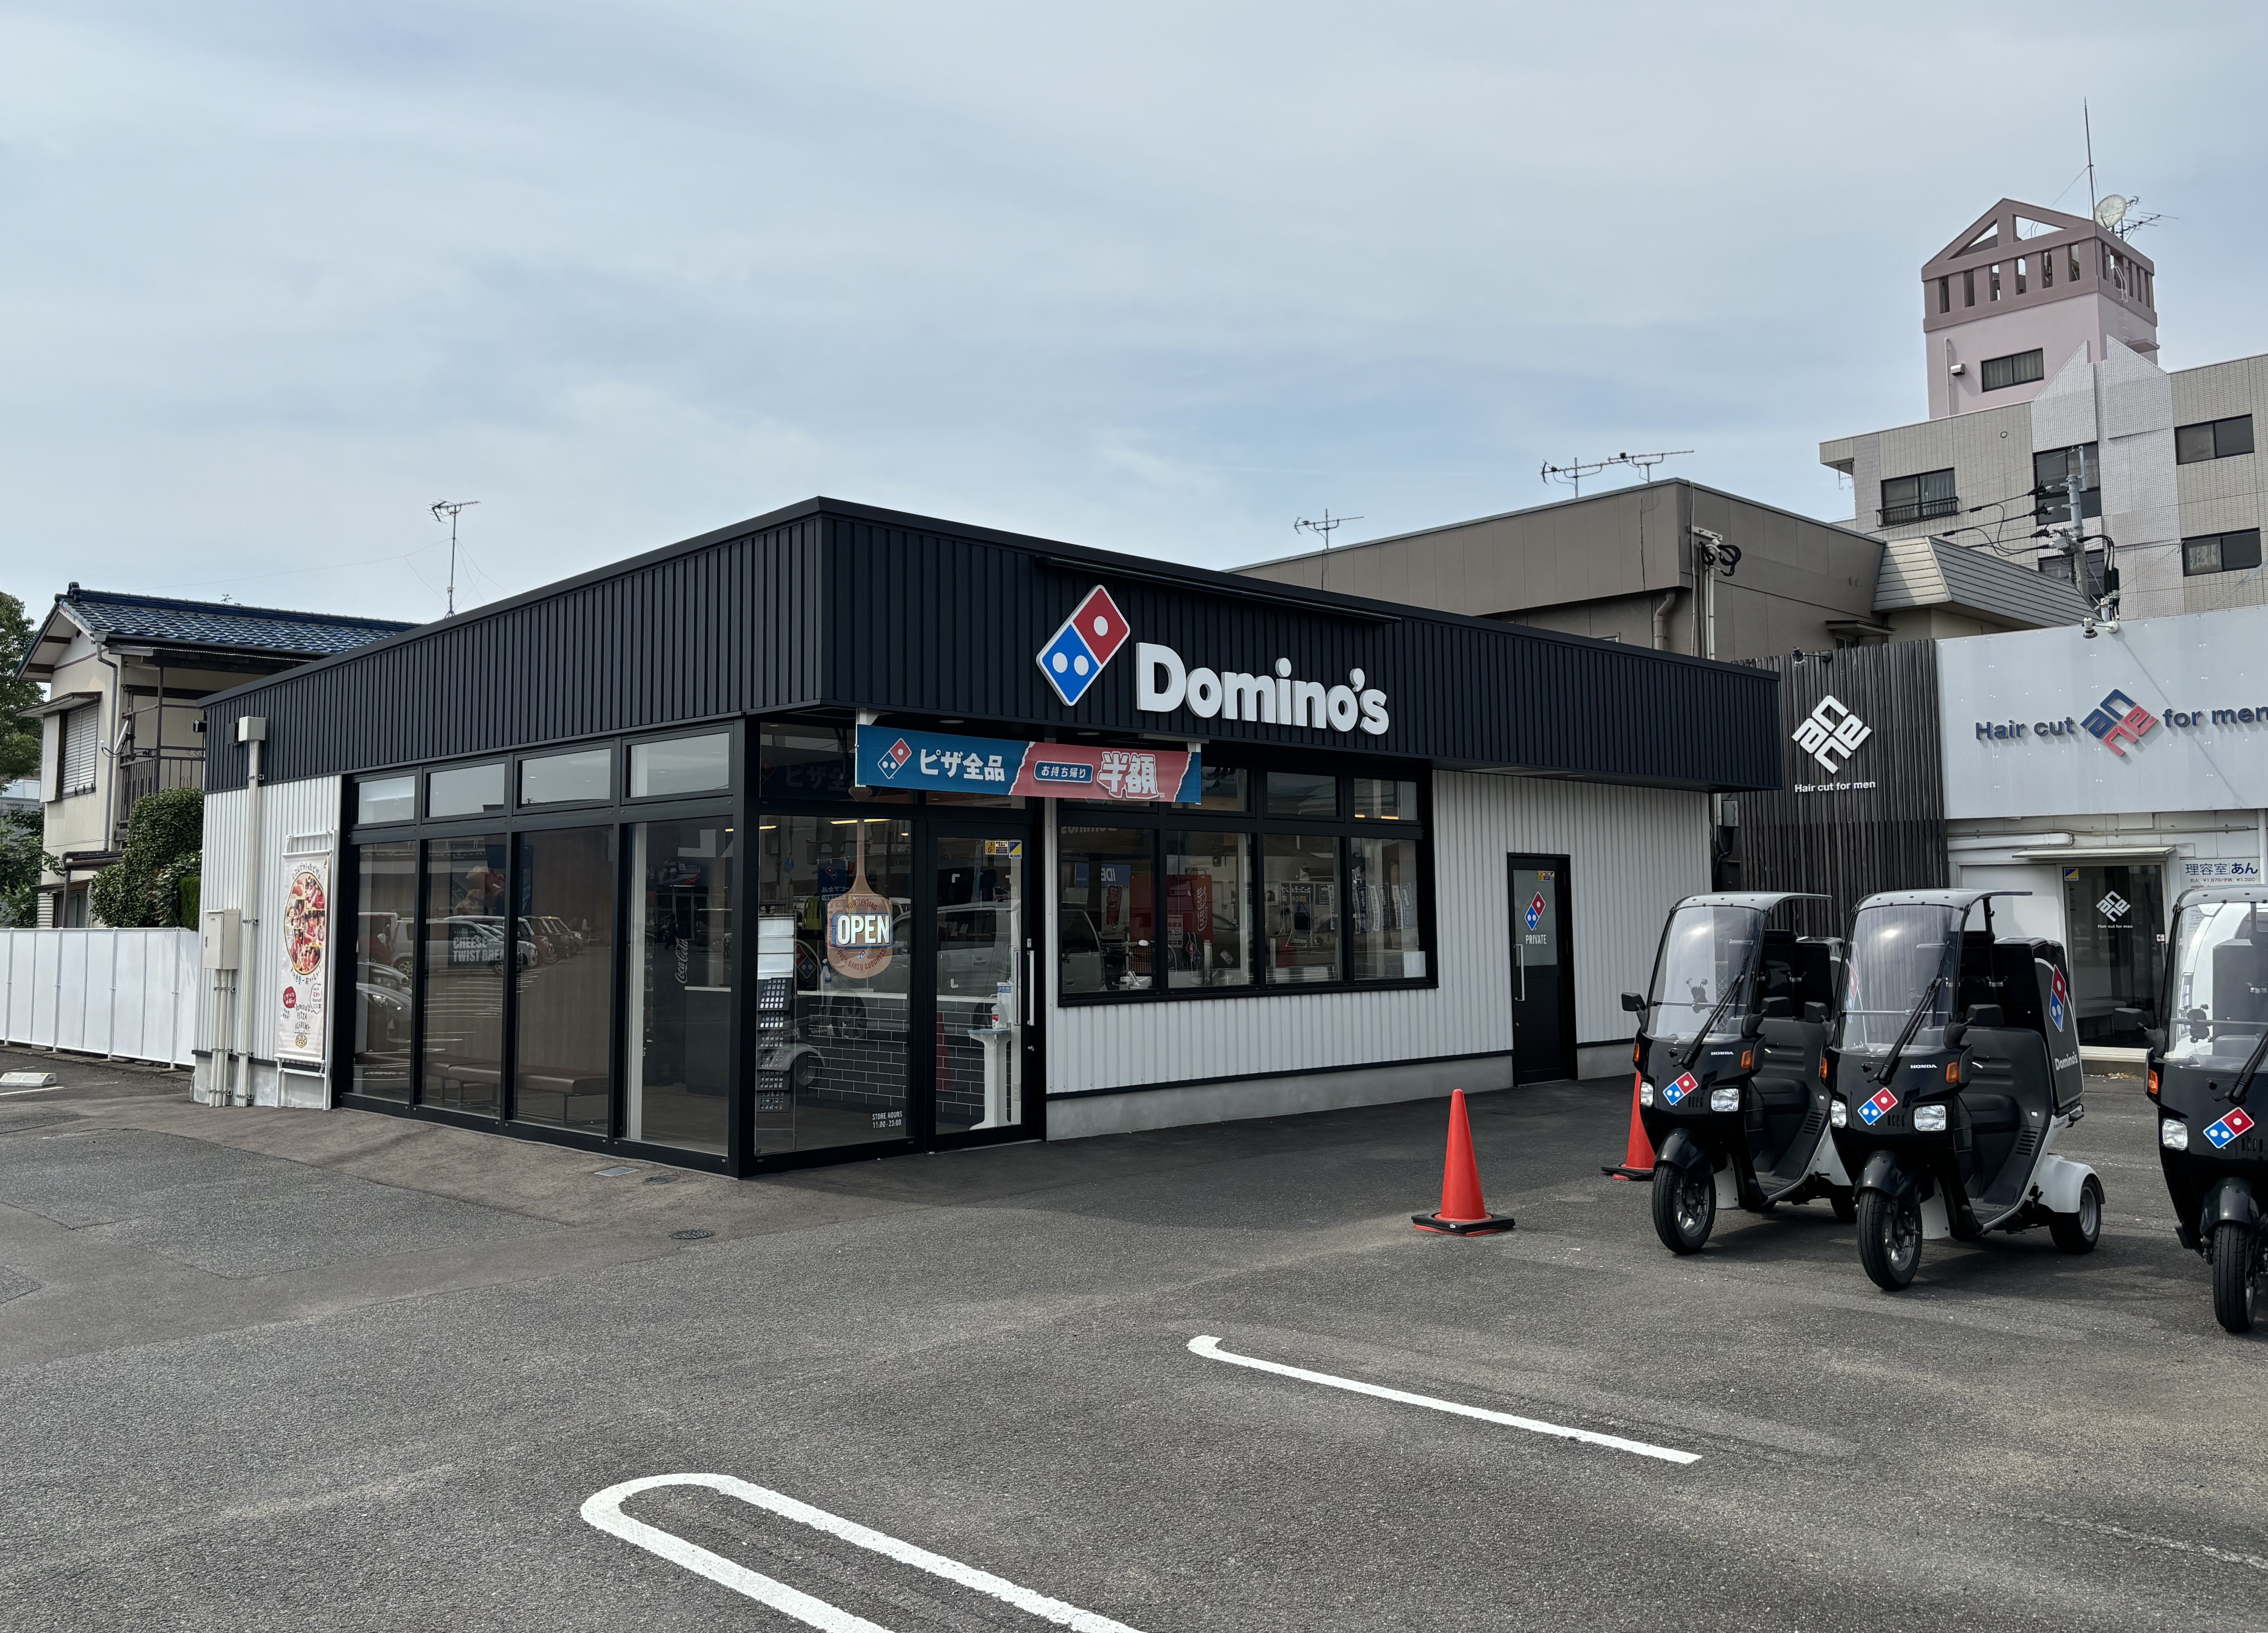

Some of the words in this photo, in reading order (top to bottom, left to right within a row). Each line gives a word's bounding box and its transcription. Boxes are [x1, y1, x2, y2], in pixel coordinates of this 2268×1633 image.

[1136, 642, 1389, 735] Domino's
[1975, 719, 2026, 740] Hair
[2034, 716, 2075, 737] cut
[2162, 708, 2203, 728] for
[2211, 706, 2268, 725] men
[921, 748, 1005, 781] ピザ全品
[1041, 765, 1086, 778] お持ち帰り
[1098, 753, 1157, 795] 半額
[1795, 784, 1816, 792] Hair
[1817, 783, 1834, 792] cut
[1836, 782, 1852, 790] for
[2185, 863, 2228, 875] 理容室
[2231, 863, 2258, 874] あん
[846, 900, 857, 911] NOW
[858, 899, 878, 911] SERVING
[838, 915, 890, 945] OPEN
[453, 936, 487, 949] CHEESE
[1526, 934, 1547, 944] PRIVATE
[453, 950, 481, 962] TWIST
[848, 960, 863, 970] BAKED
[865, 949, 886, 970] GOODNESS
[2055, 1051, 2078, 1071] Domino's
